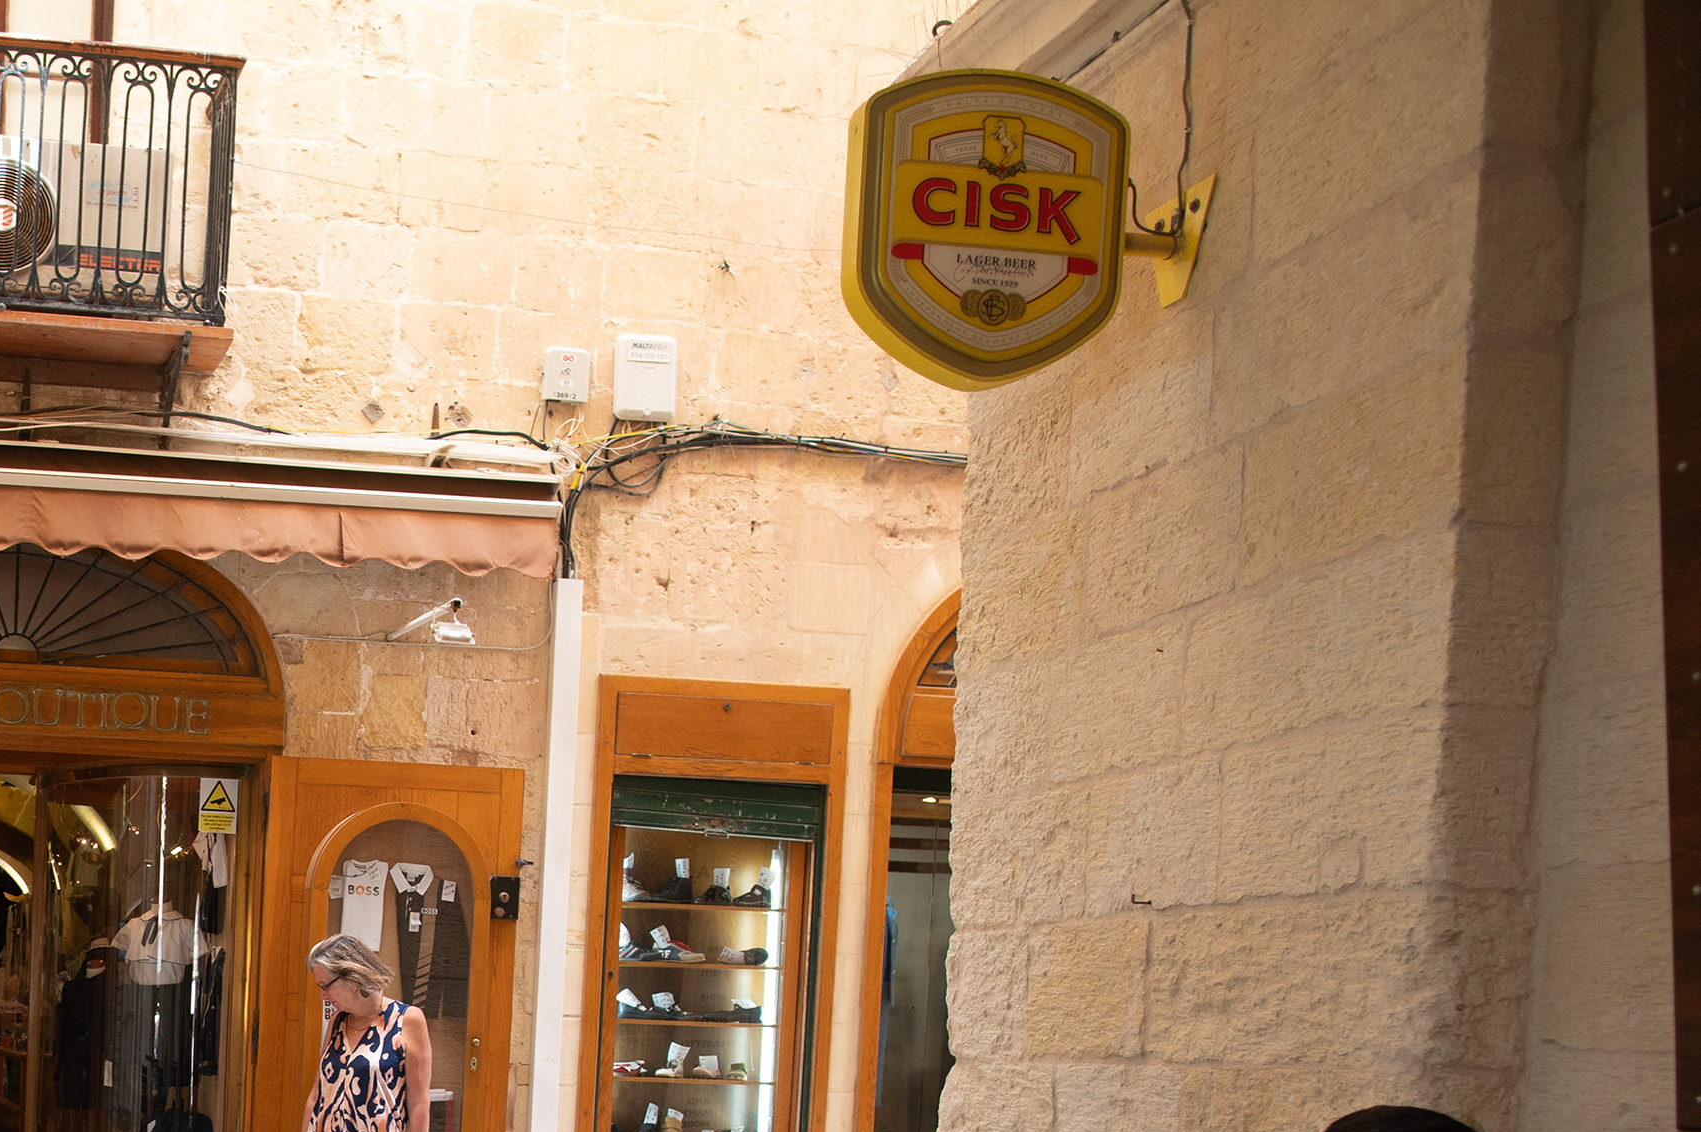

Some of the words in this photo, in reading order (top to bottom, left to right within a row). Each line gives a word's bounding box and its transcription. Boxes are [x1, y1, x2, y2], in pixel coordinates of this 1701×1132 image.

[911, 176, 1083, 246] CISK
[956, 253, 1000, 267] LAGER
[1004, 257, 1036, 271] BEER
[971, 277, 999, 287] SINCE
[1000, 280, 1019, 289] 1929
[906, 286, 968, 336] INDEPENDENT
[347, 884, 380, 897] BOSS
